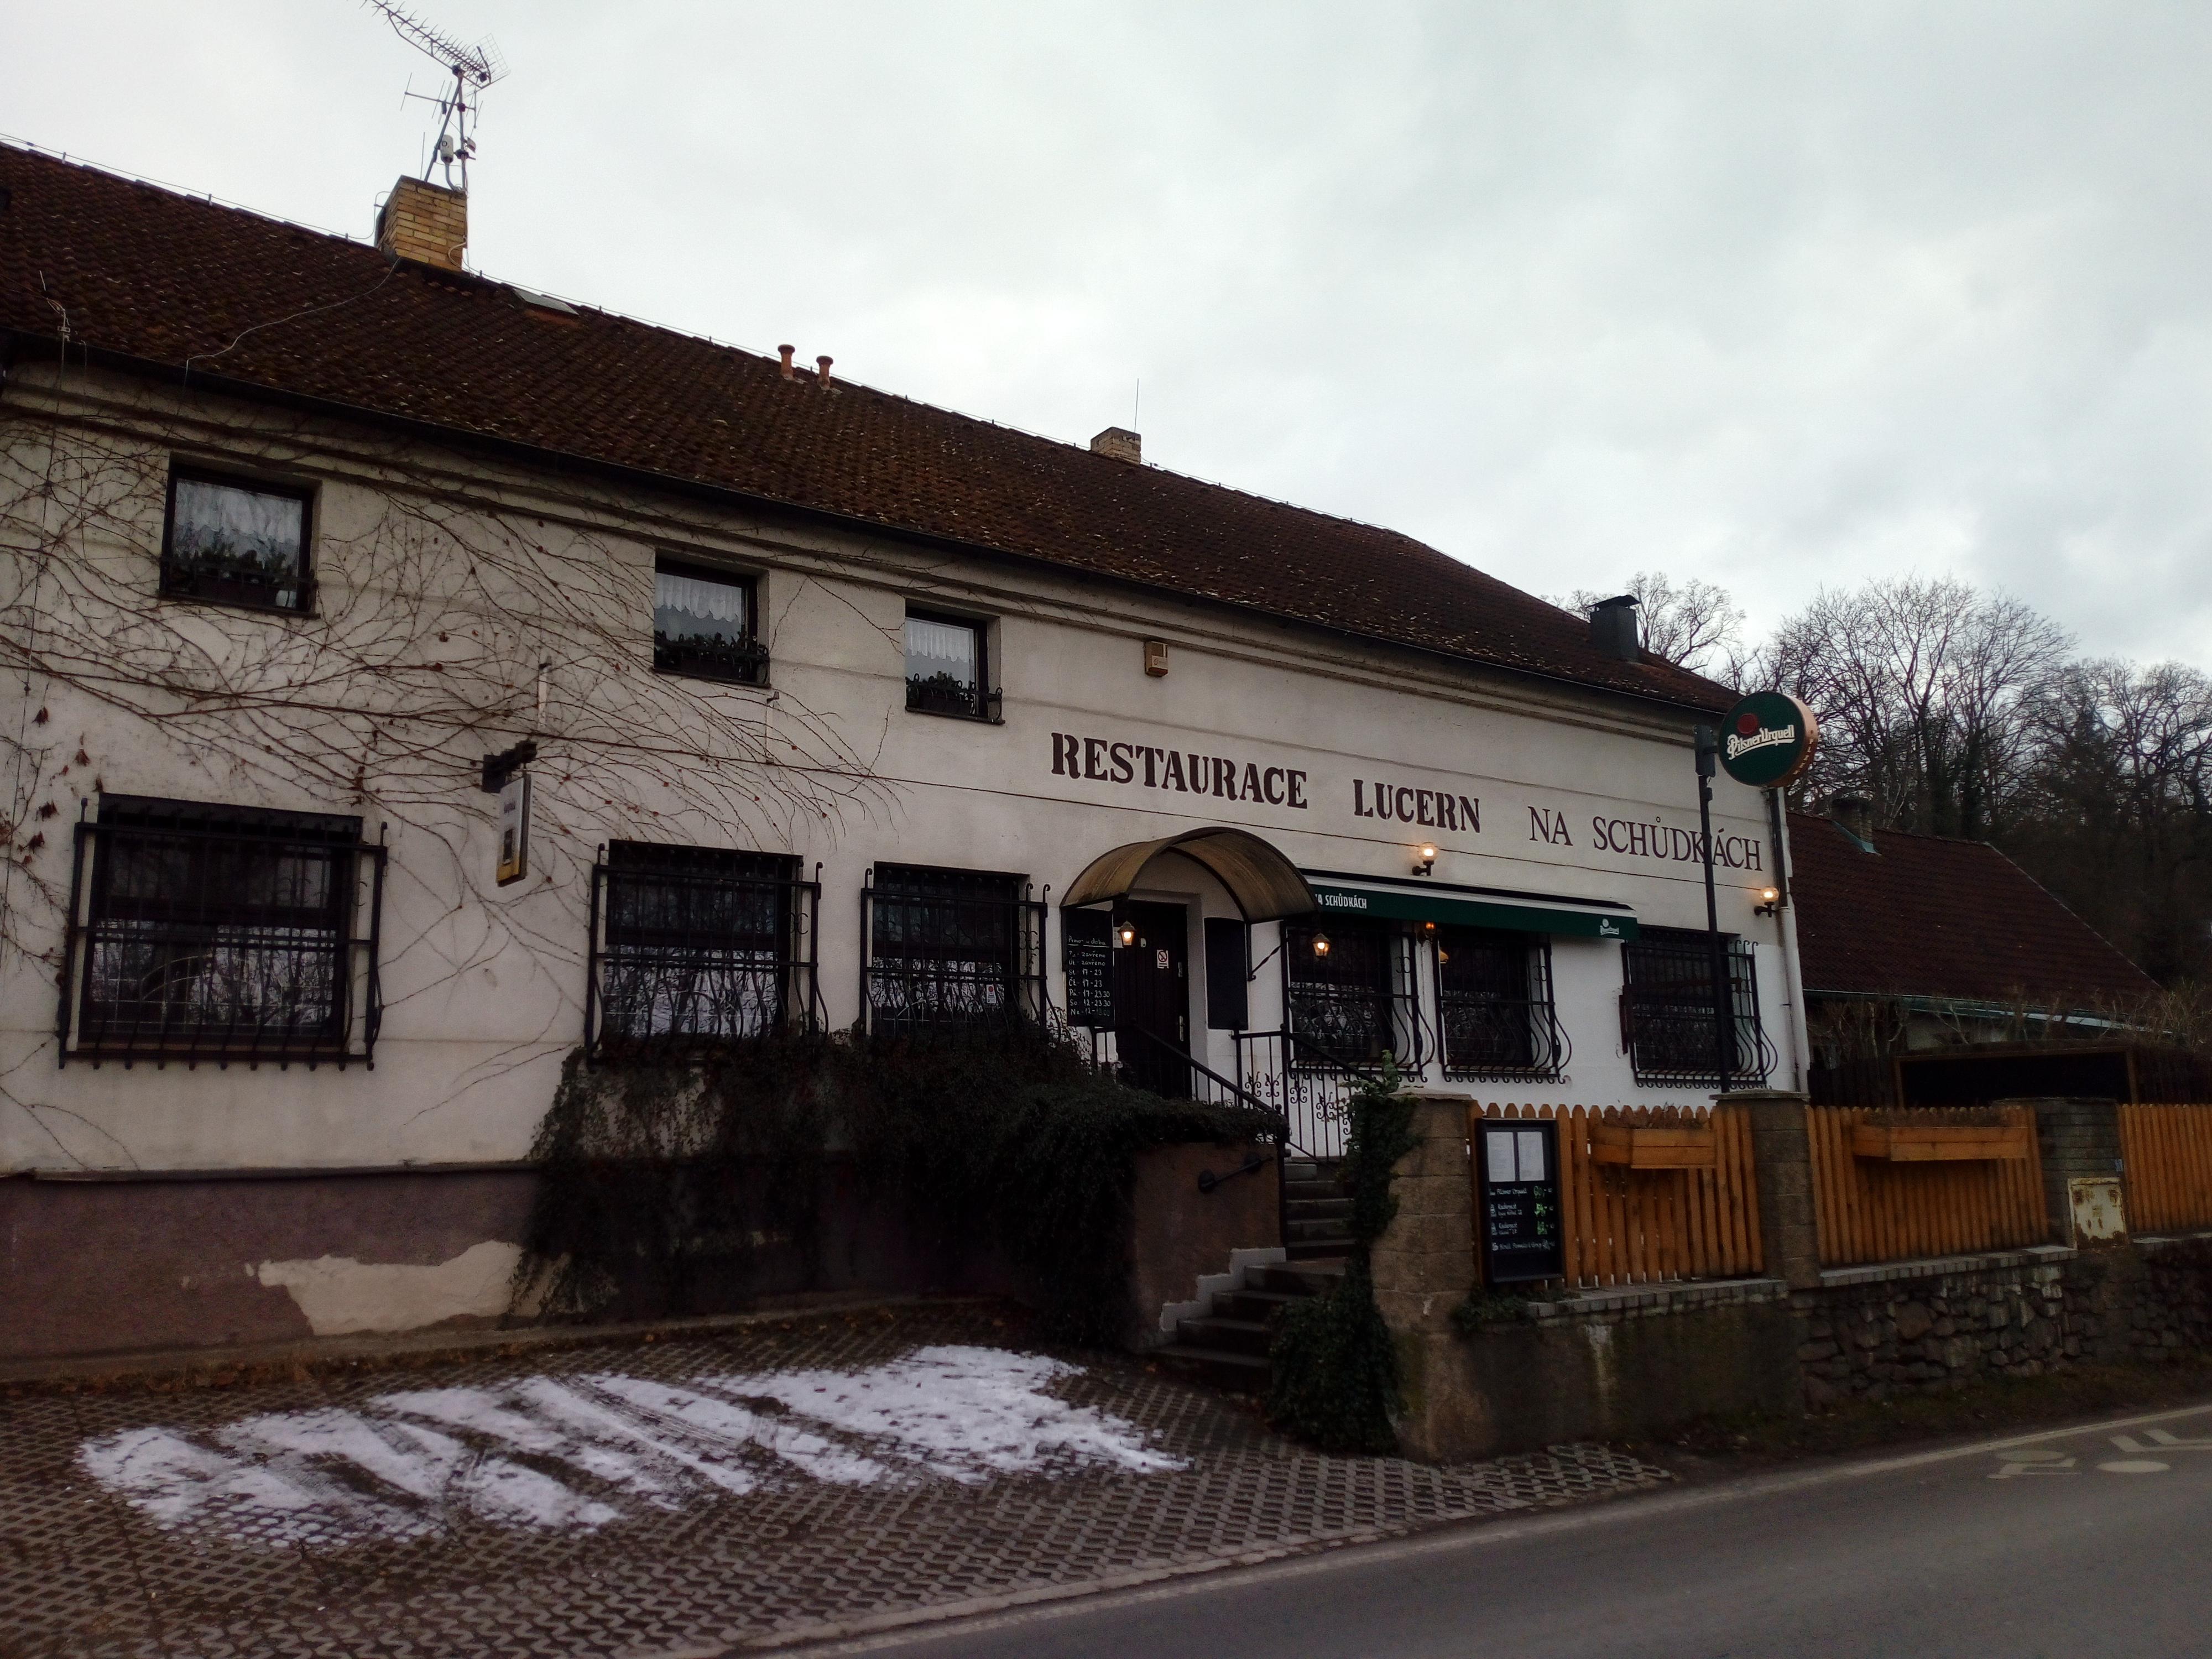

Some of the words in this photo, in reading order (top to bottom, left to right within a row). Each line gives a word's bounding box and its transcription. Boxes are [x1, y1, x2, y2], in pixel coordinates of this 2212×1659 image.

[1726, 734, 1762, 760] Pilsner
[1759, 724, 1795, 746] Urquell
[1051, 732, 1308, 810] RESTAURACE
[1352, 779, 1481, 834] LUCERN
[1527, 806, 1573, 847] NA
[1592, 816, 1764, 872] SCHŮDKÁCH
[1314, 893, 1323, 905] A
[1325, 893, 1367, 909] SCHŮDKÁCH
